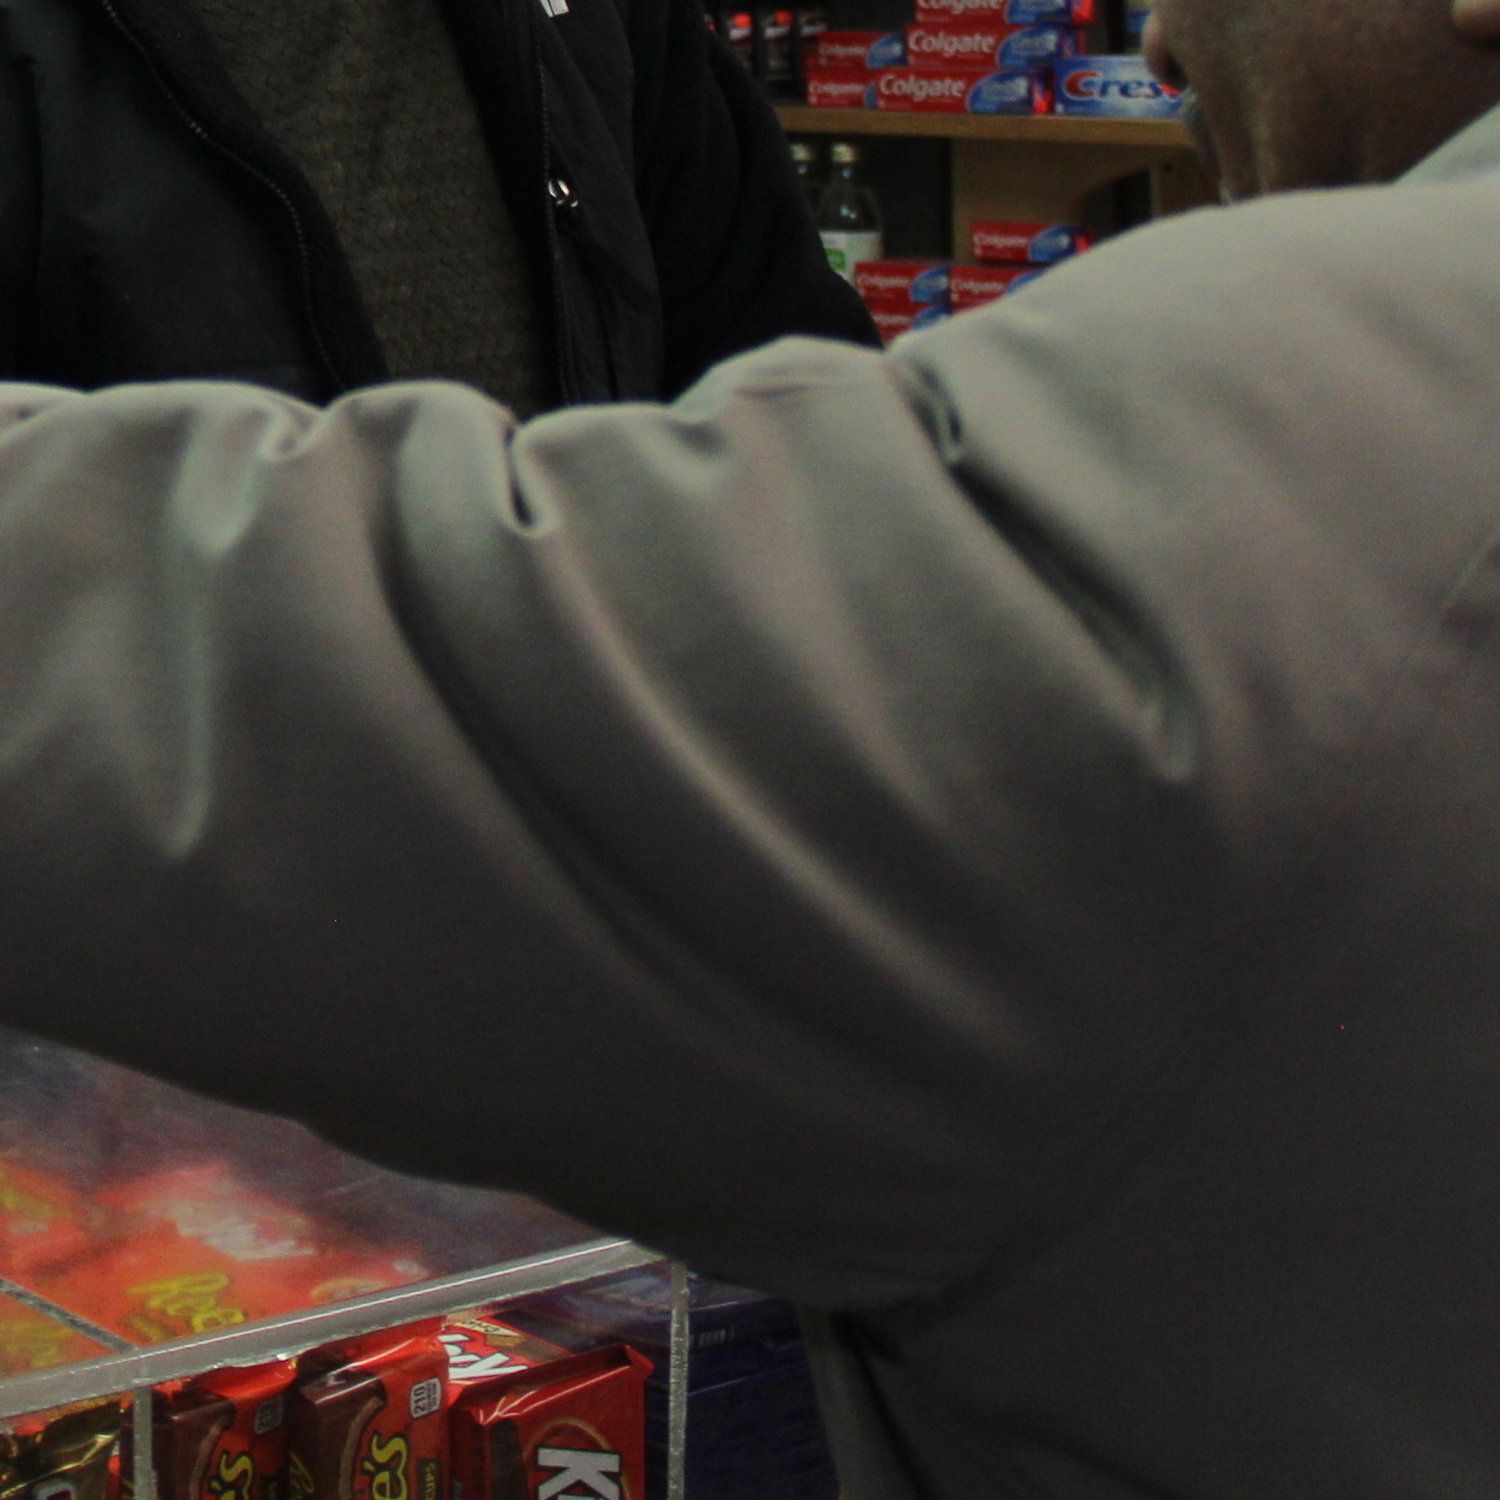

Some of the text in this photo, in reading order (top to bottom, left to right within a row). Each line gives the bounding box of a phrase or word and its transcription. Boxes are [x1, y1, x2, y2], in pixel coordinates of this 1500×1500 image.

[908, 29, 996, 56] Colgate
[879, 74, 967, 101] Colgate
[1065, 70, 1176, 100] Cres
[412, 1386, 427, 1414] 210
